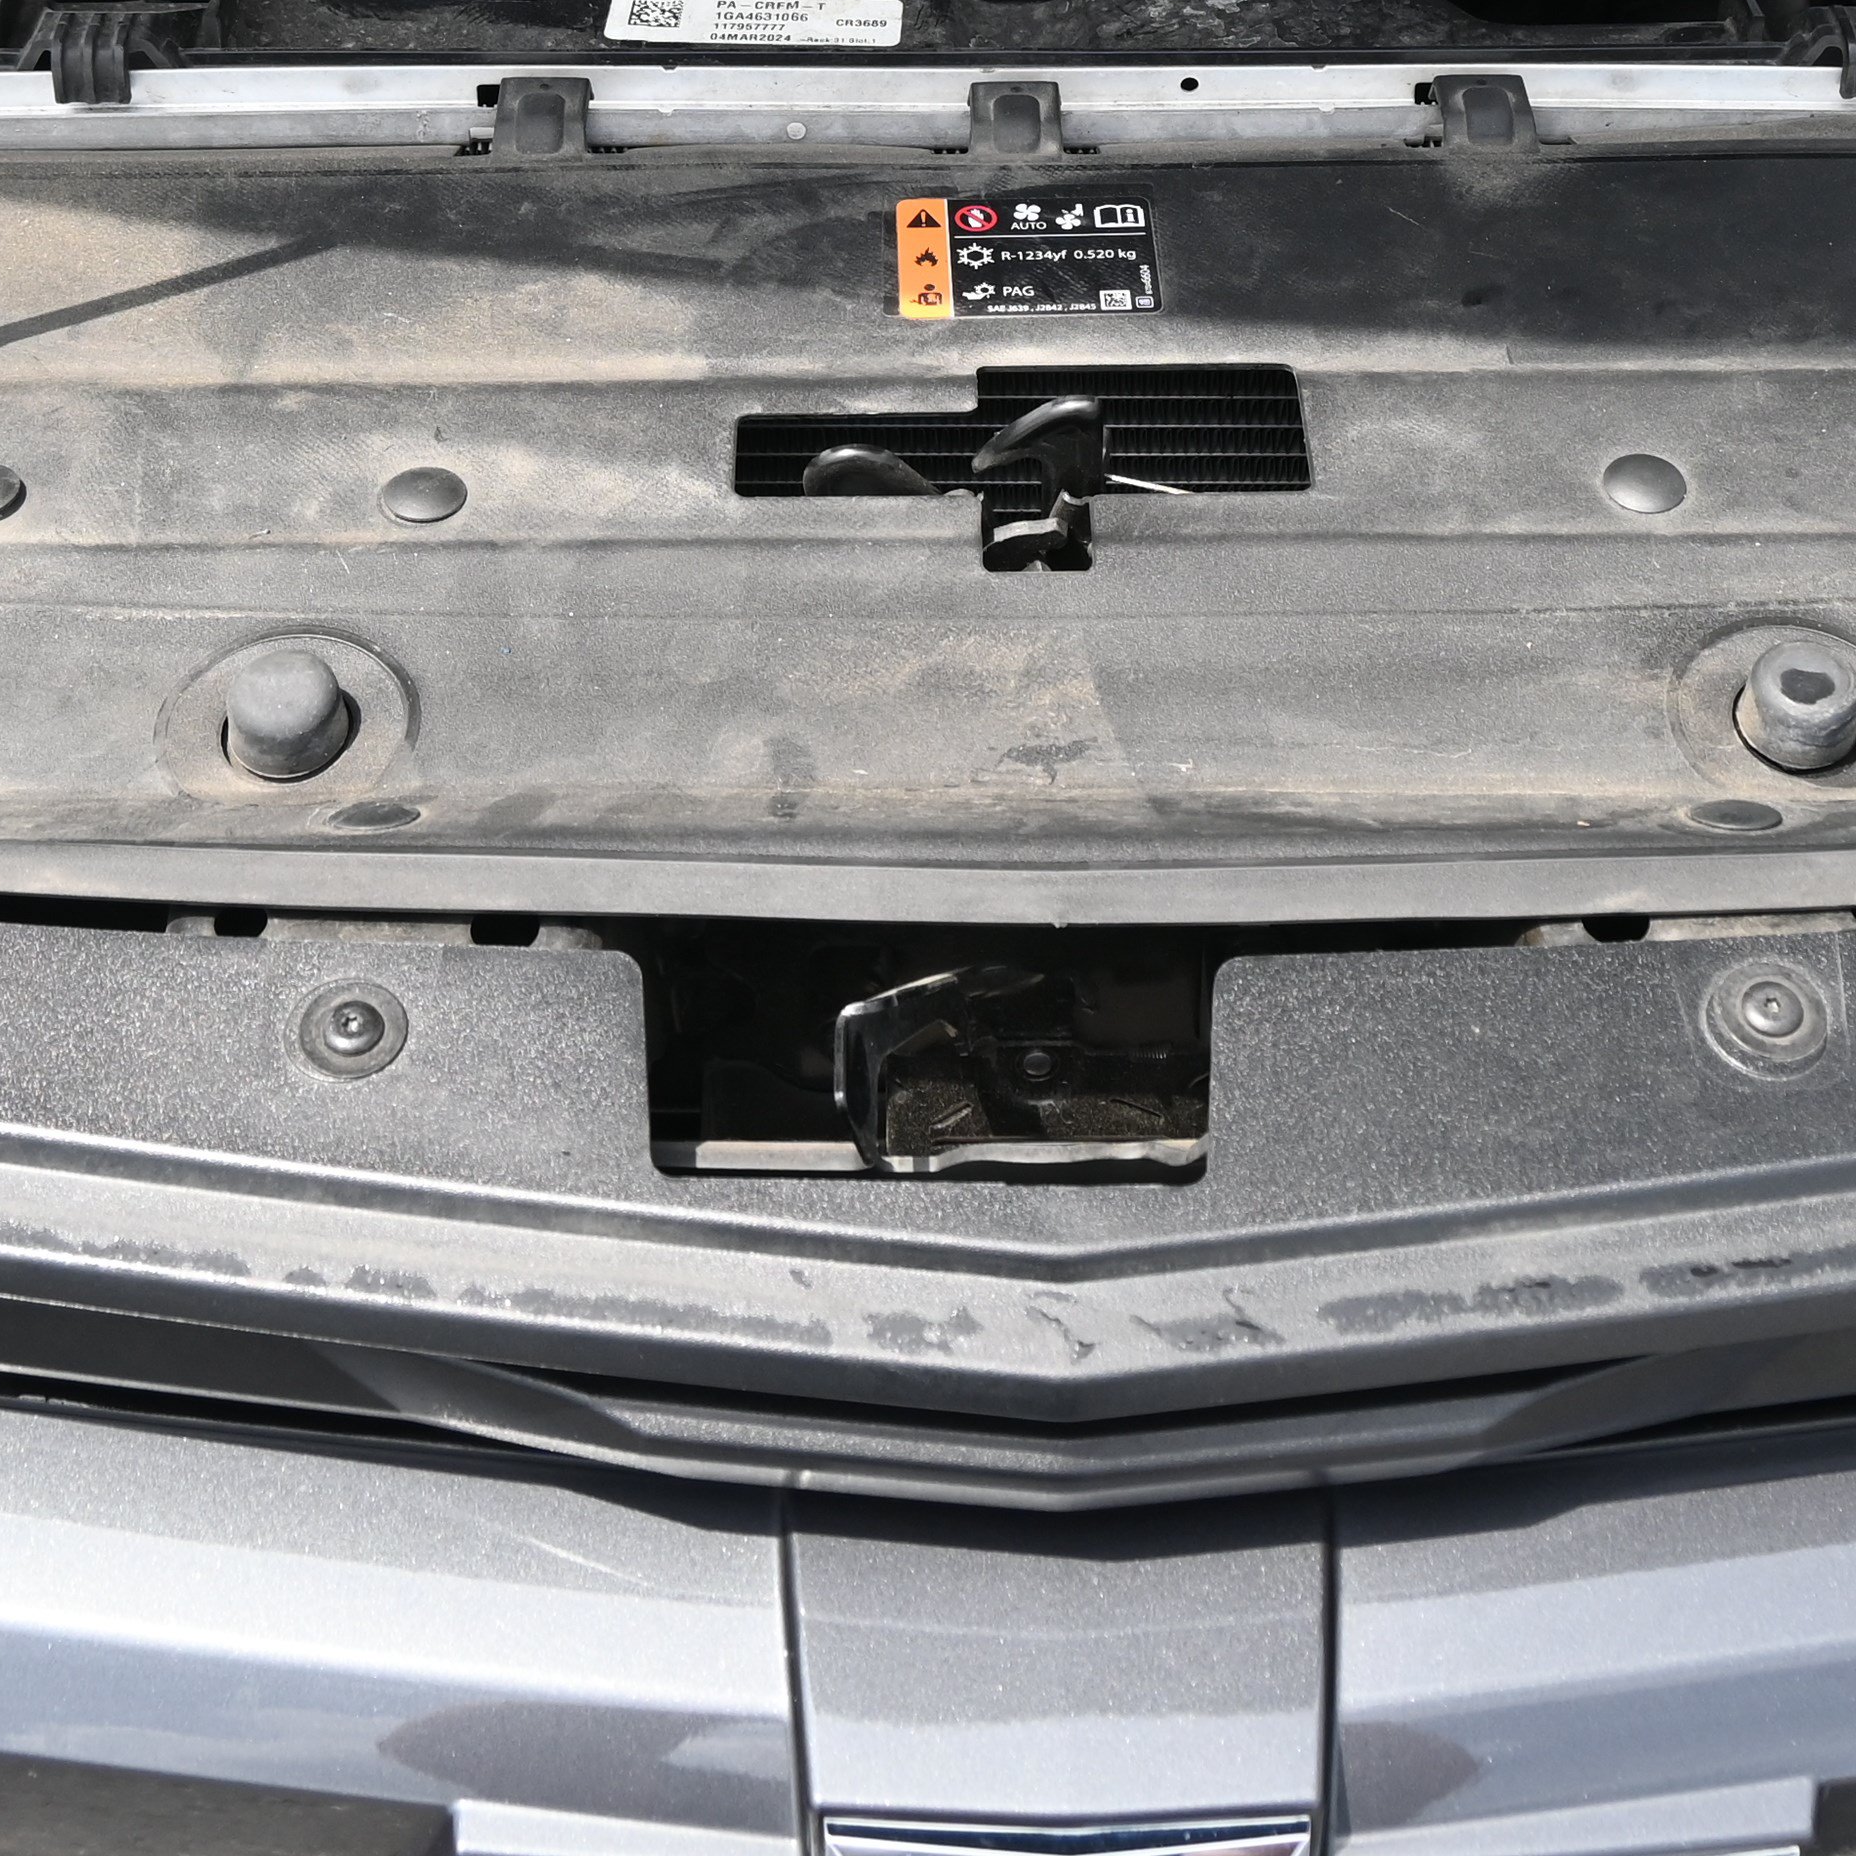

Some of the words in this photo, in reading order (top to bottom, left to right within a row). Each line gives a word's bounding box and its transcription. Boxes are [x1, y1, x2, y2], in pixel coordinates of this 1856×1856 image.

[715, 11, 809, 22] 1GA4631066
[835, 18, 888, 28] CR3689
[710, 32, 792, 42] 04MAR2024
[1010, 221, 1047, 231] AUTO
[1001, 249, 1067, 262] R-1234yf
[1073, 249, 1115, 260] 0.520
[1118, 248, 1137, 261] kg
[1002, 285, 1035, 297] PAG
[986, 304, 1006, 313] SAE
